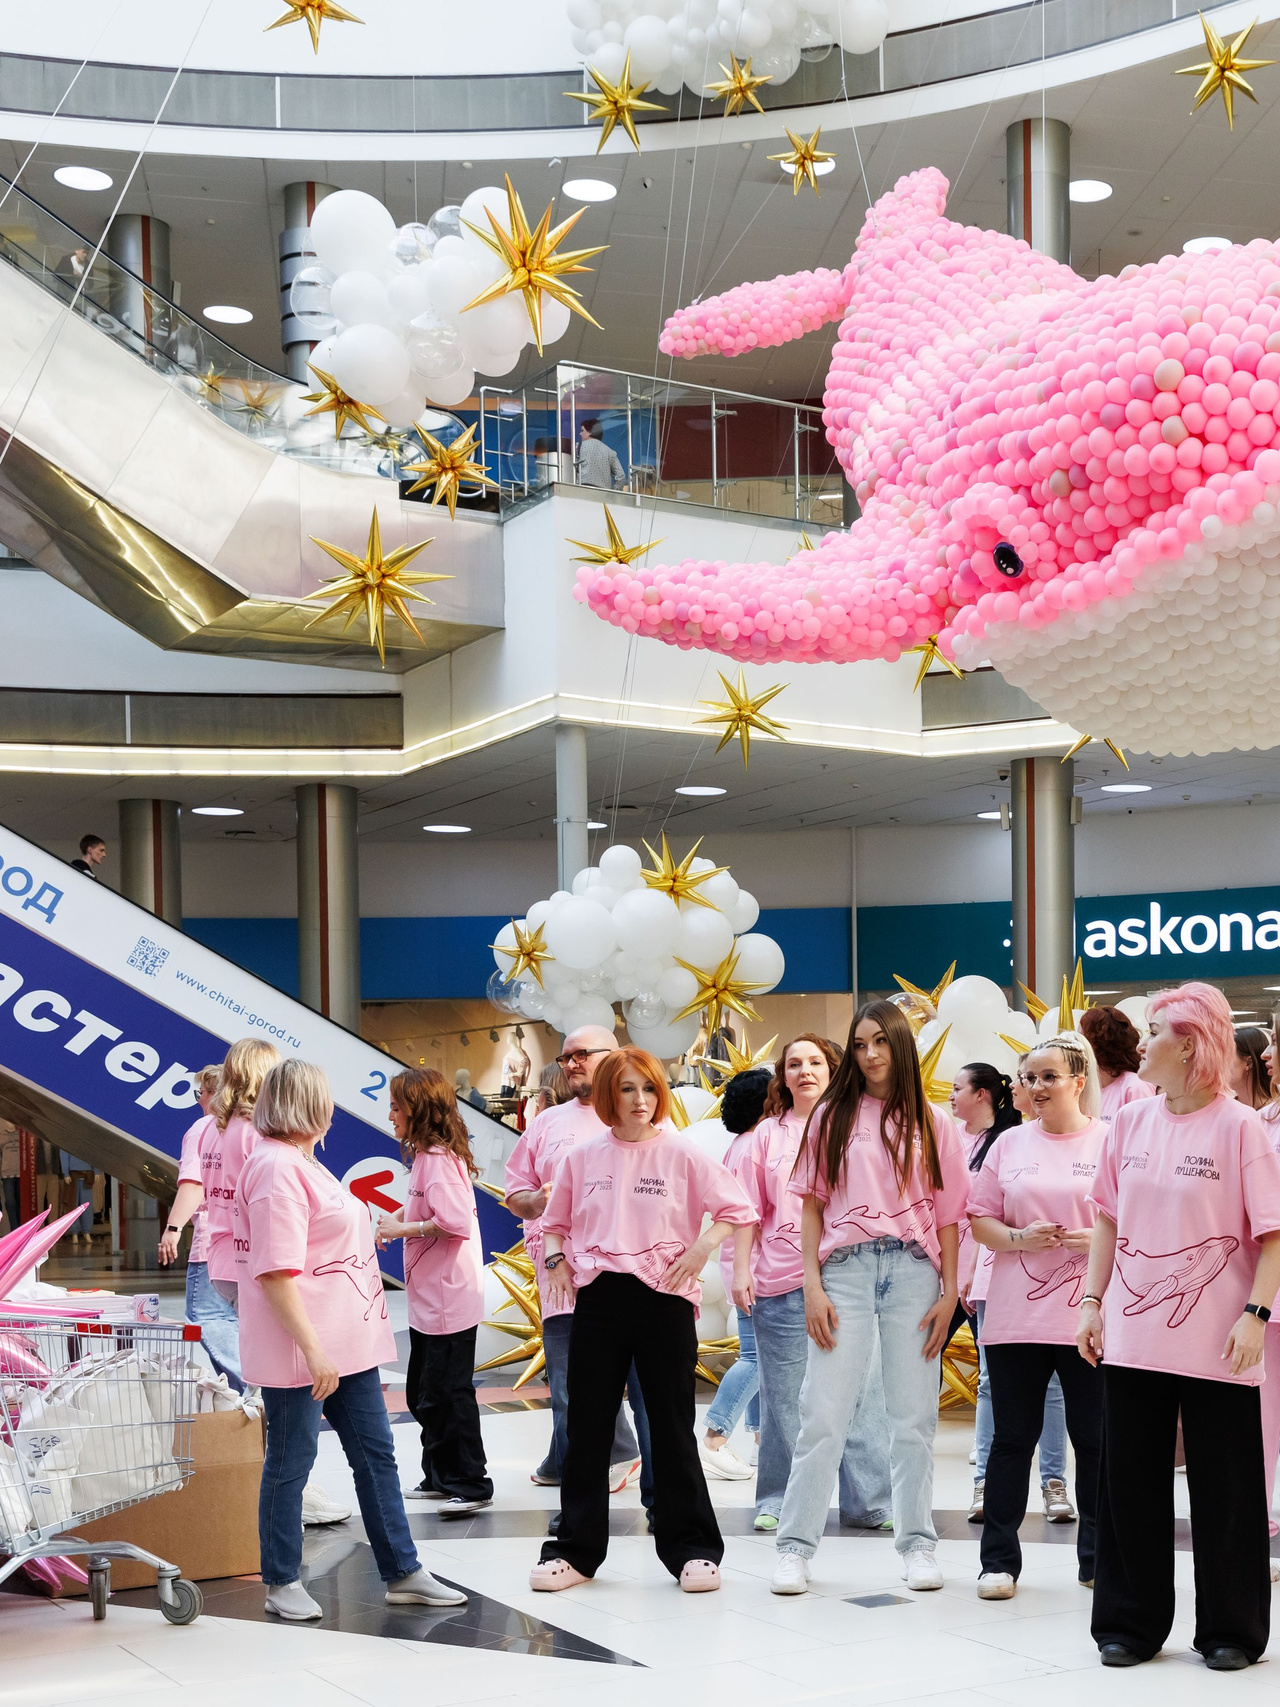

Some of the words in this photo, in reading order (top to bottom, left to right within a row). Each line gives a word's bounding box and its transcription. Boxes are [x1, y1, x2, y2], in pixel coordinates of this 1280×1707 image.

[175, 967, 301, 1049] www.chitai-gorod.ru
[1072, 1162, 1097, 1170] НАДЕЖ
[1184, 1156, 1215, 1167] ПОЛИНА
[640, 1177, 665, 1187] МАРИНА
[634, 1186, 668, 1197] КИРИЕНКО
